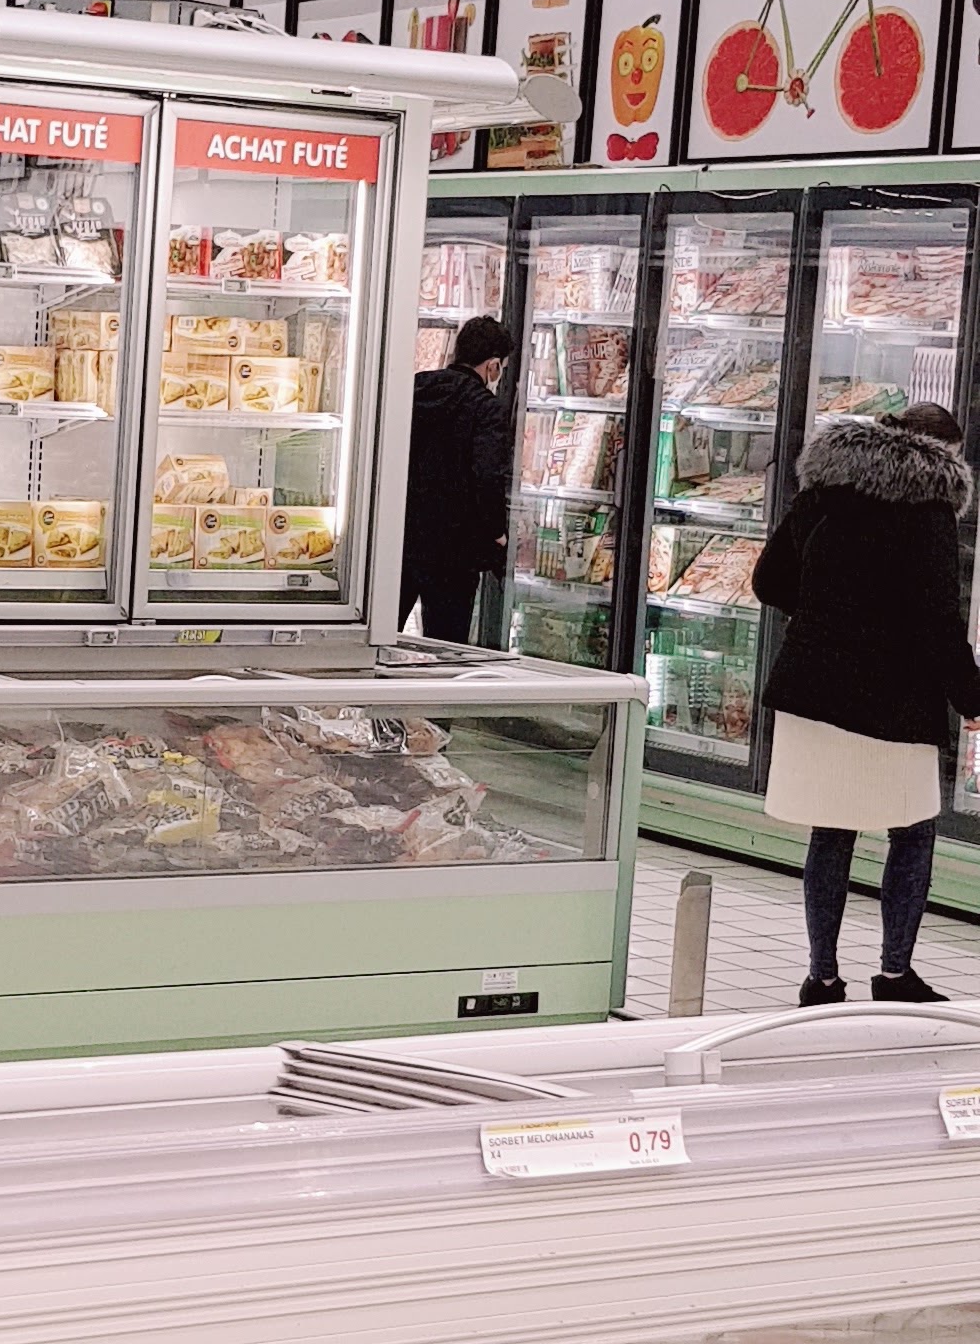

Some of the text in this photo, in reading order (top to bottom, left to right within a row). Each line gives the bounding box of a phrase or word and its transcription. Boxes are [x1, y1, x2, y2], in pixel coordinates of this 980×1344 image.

[49, 117, 108, 149] FUTÉ
[207, 134, 348, 170] ACHAT FUTÉ
[489, 1131, 594, 1147] SORBET MELONANANAS
[629, 1130, 671, 1156] 0,79
[491, 1151, 501, 1159] X4
